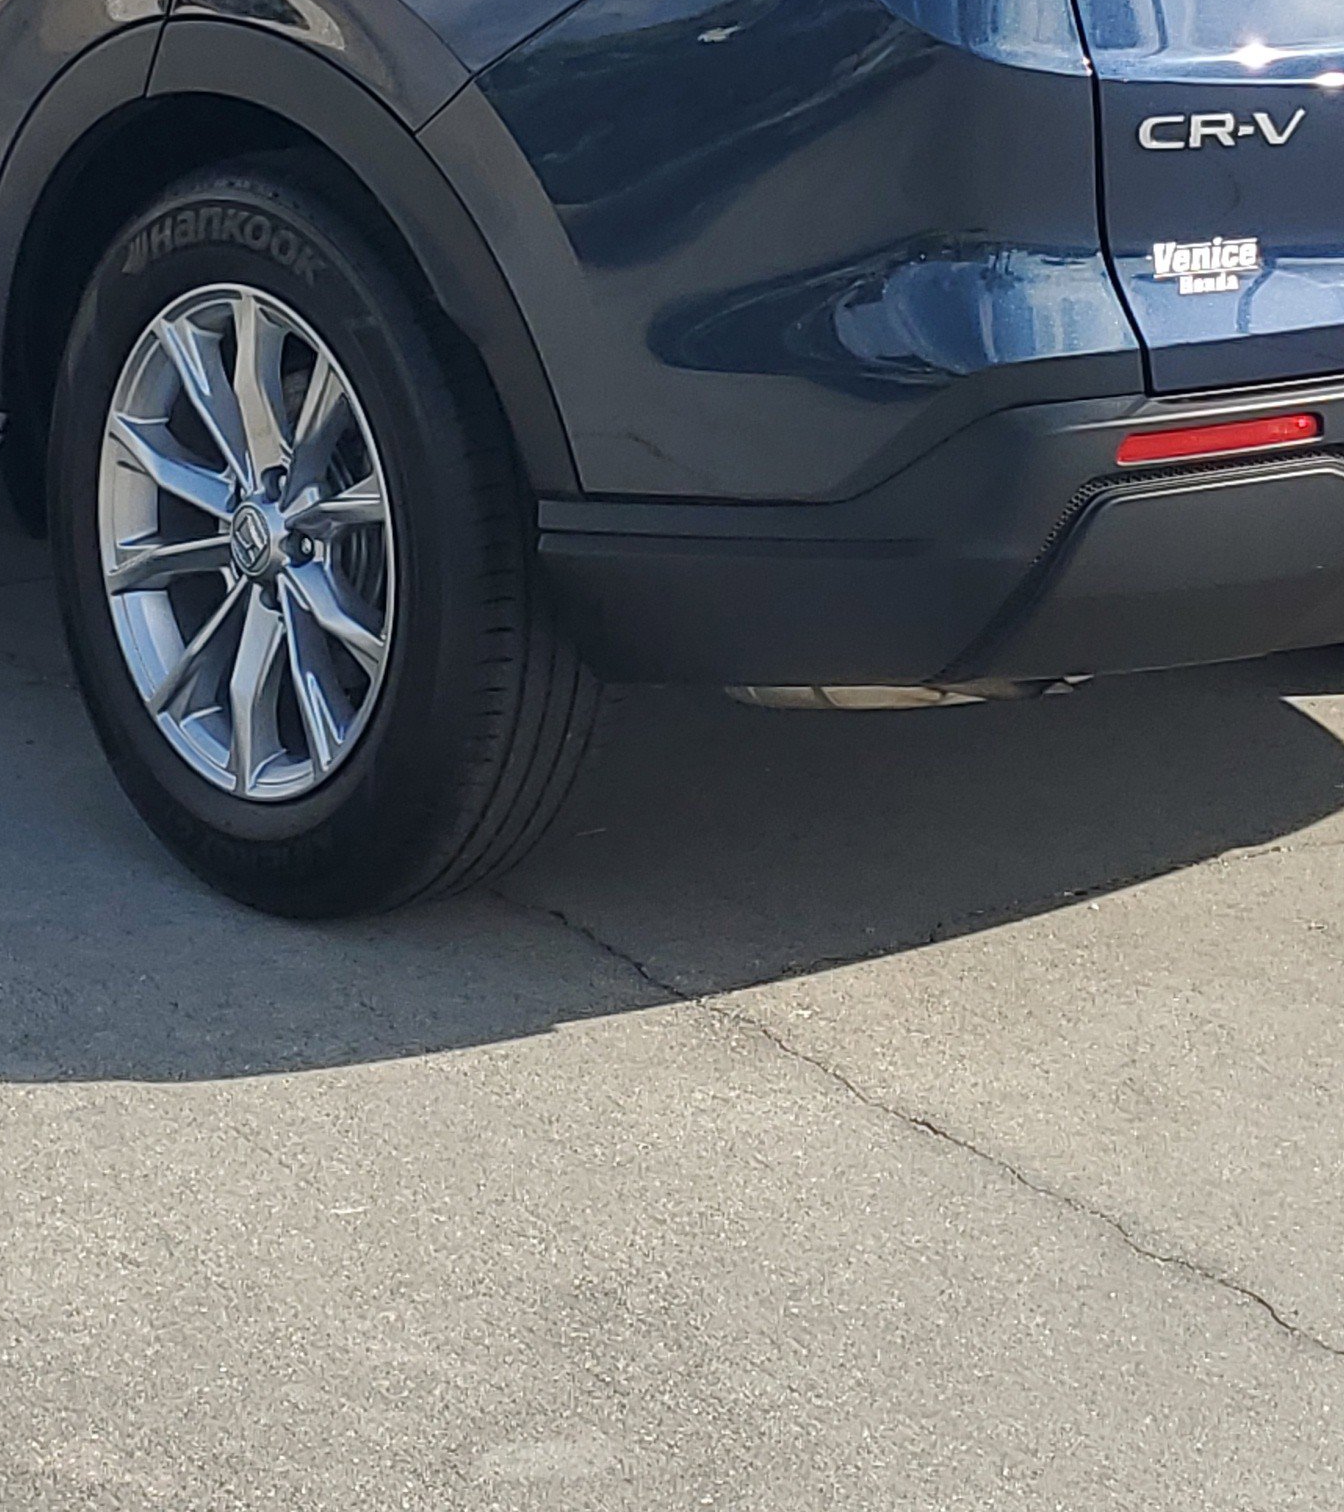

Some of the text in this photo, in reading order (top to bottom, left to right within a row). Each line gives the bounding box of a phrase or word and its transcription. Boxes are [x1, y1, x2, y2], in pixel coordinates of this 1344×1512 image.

[1138, 107, 1306, 150] CR-V
[1153, 237, 1258, 274] Venice
[1179, 273, 1239, 295] Honda
